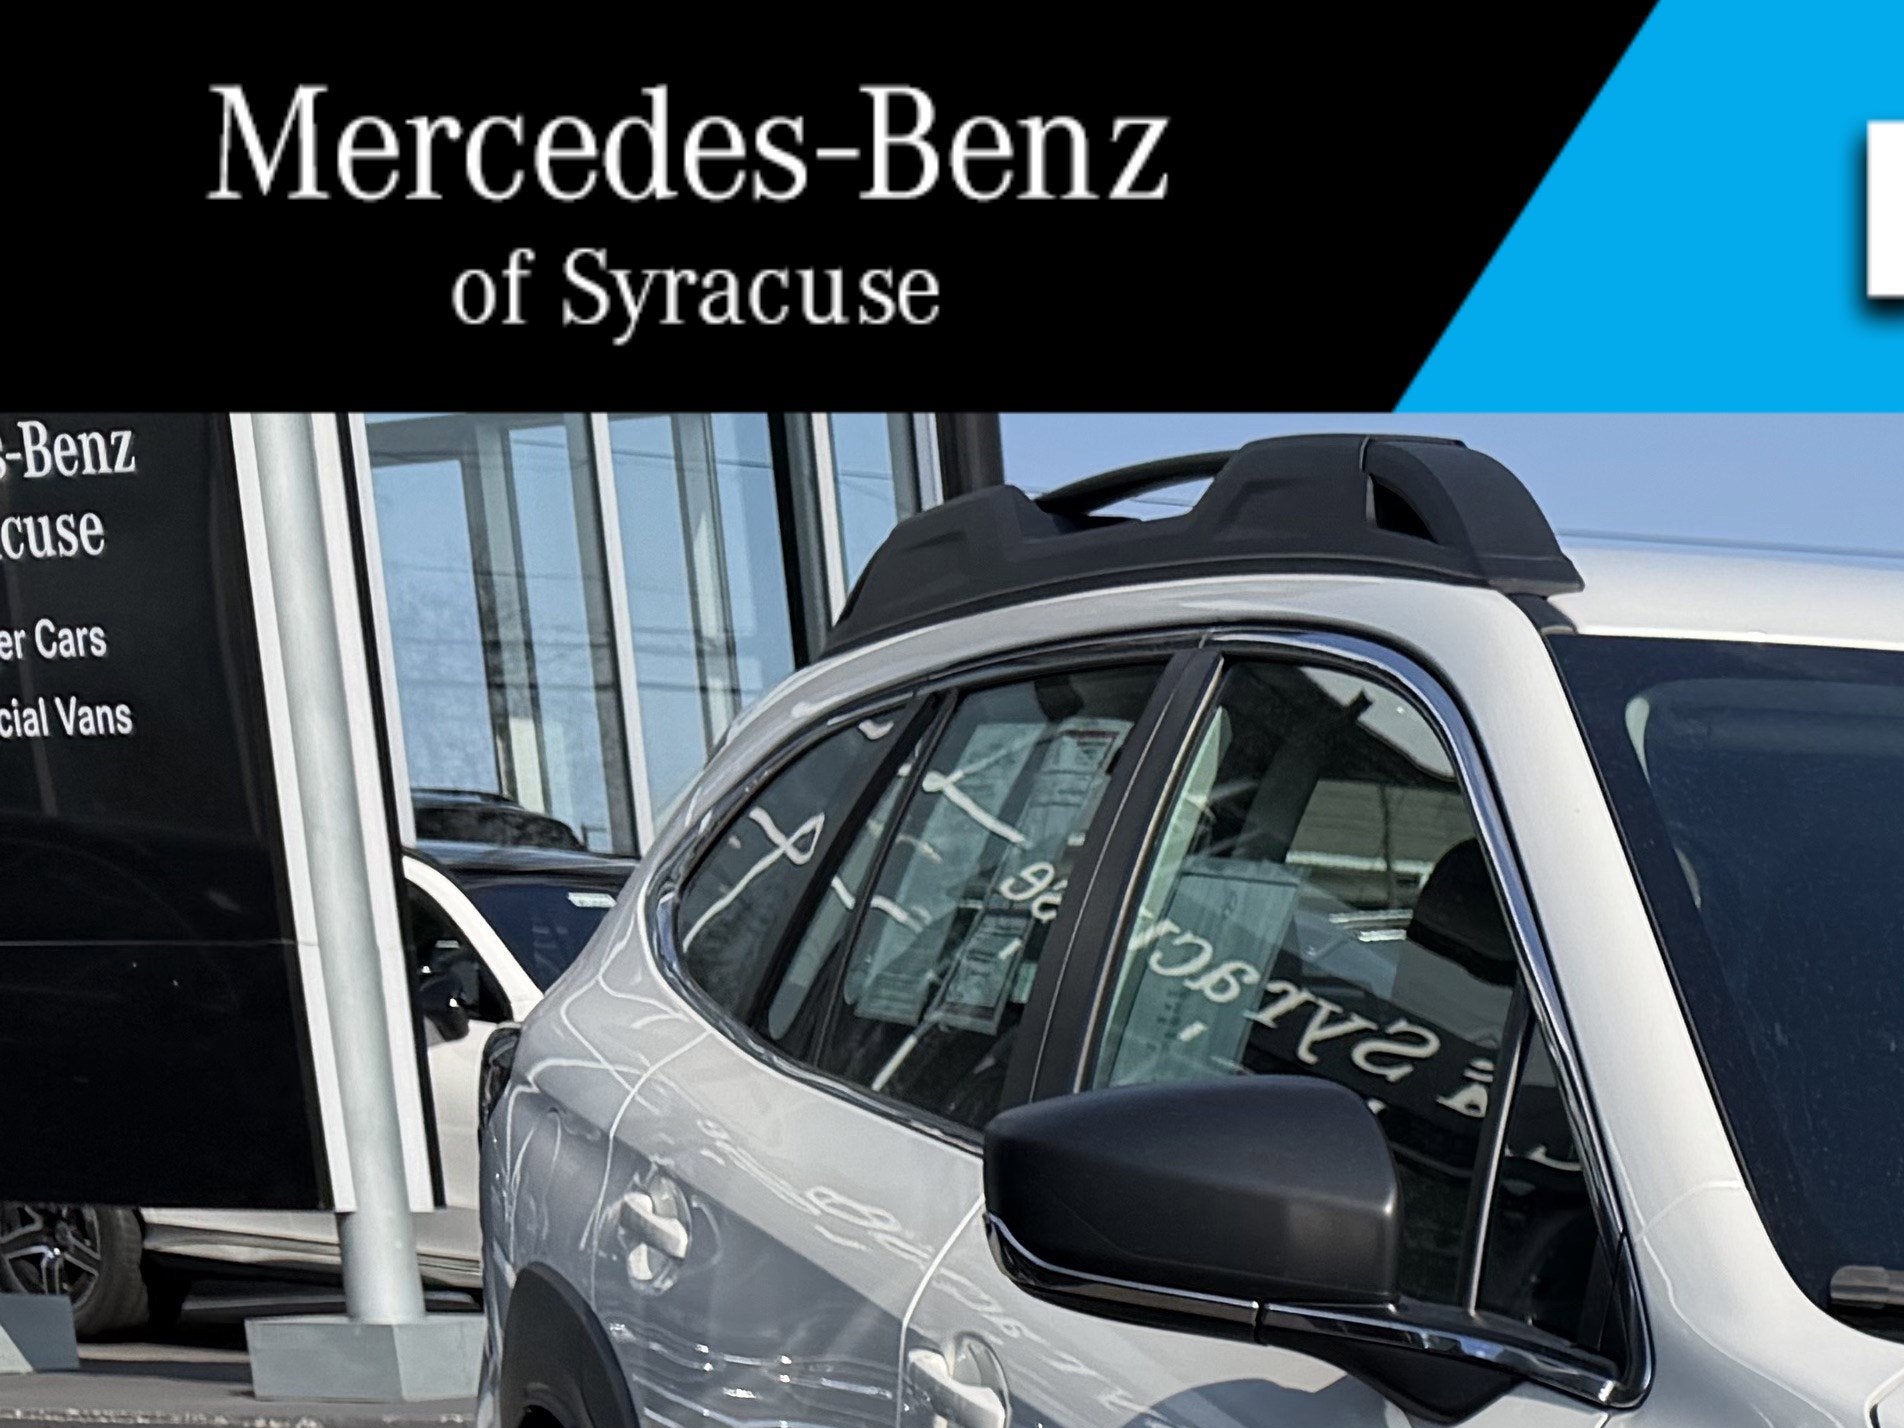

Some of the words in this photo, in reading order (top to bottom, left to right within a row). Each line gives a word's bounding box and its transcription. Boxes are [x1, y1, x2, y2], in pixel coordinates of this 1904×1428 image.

[0, 512, 106, 560] cuse
[34, 618, 107, 660] Cars
[54, 695, 133, 736] Vans
